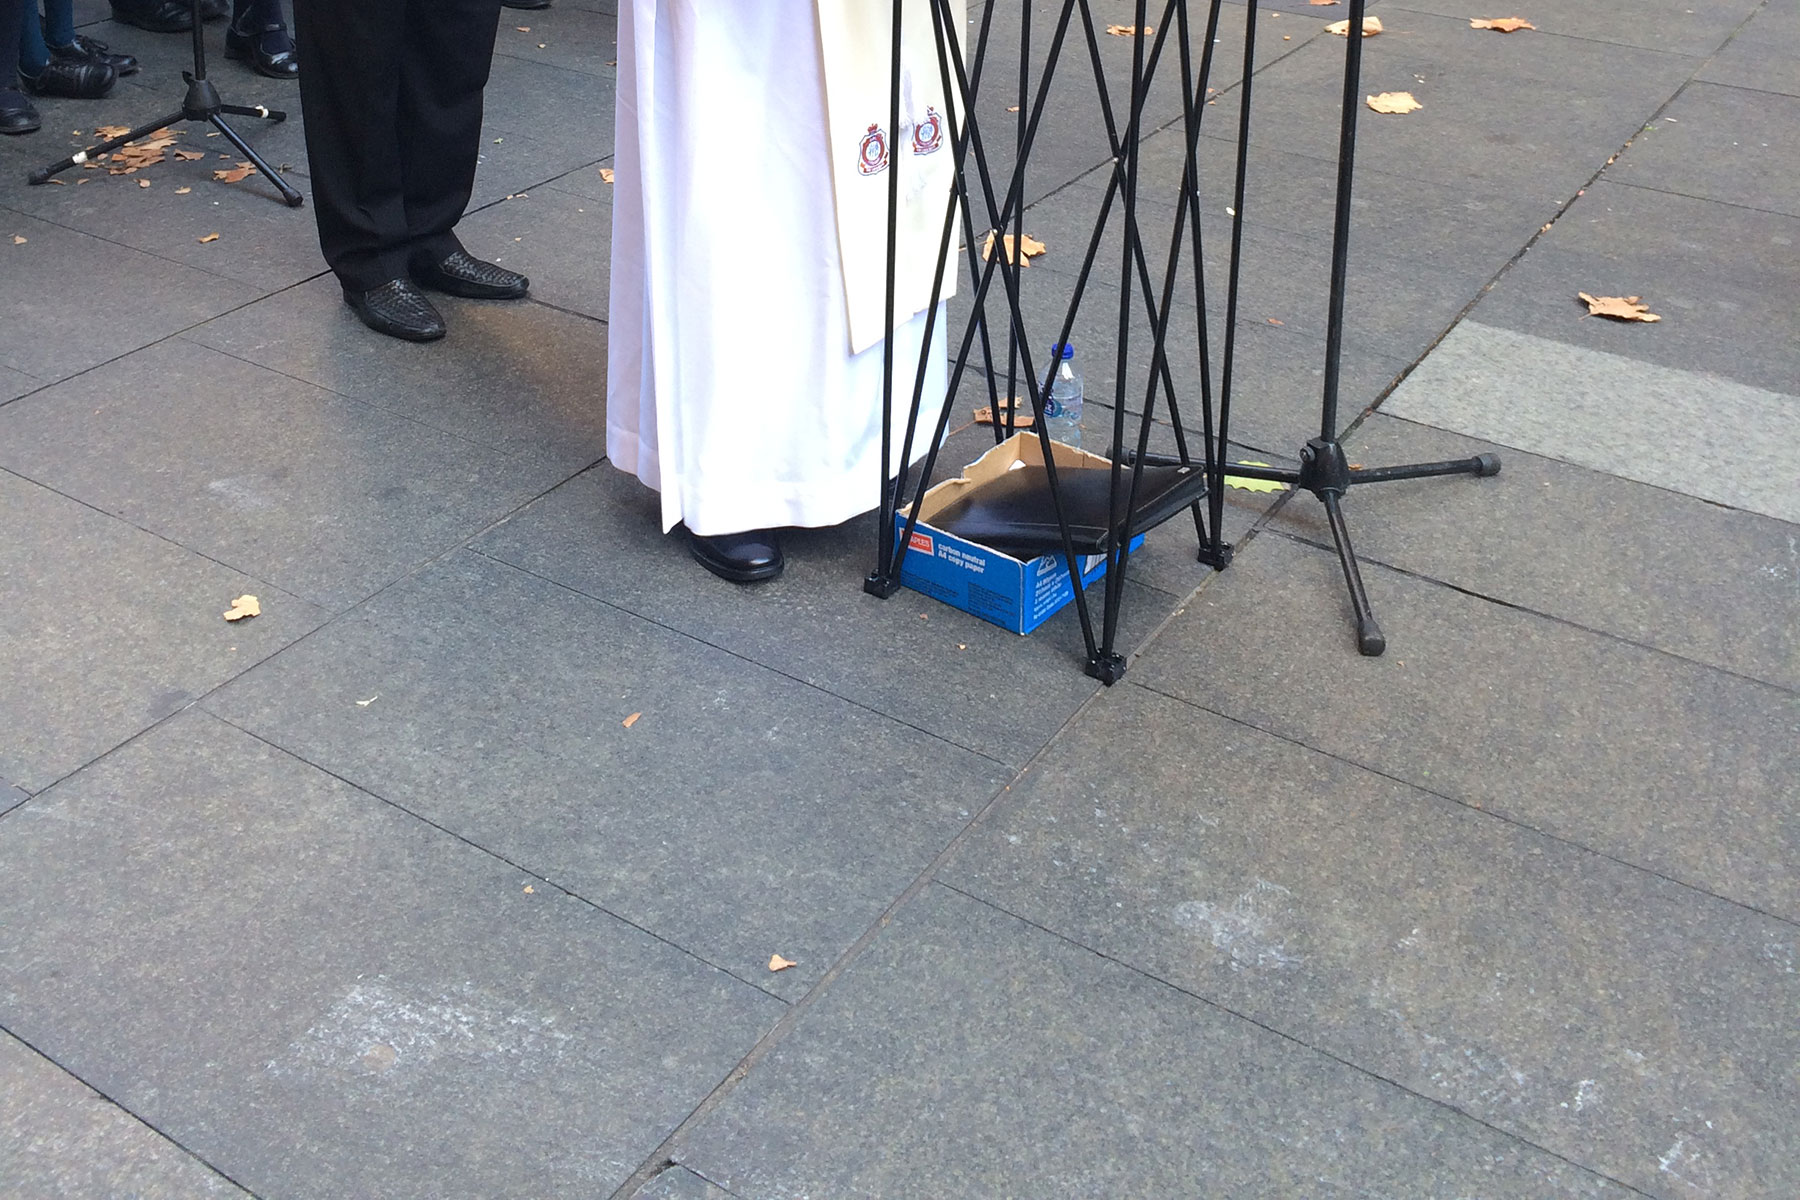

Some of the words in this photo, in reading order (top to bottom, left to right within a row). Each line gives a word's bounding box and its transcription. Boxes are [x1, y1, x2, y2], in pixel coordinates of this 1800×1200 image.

[937, 543, 961, 557] carbon
[961, 552, 986, 567] neutral
[937, 550, 947, 560] A4
[947, 556, 965, 567] copy
[964, 561, 985, 574] paper
